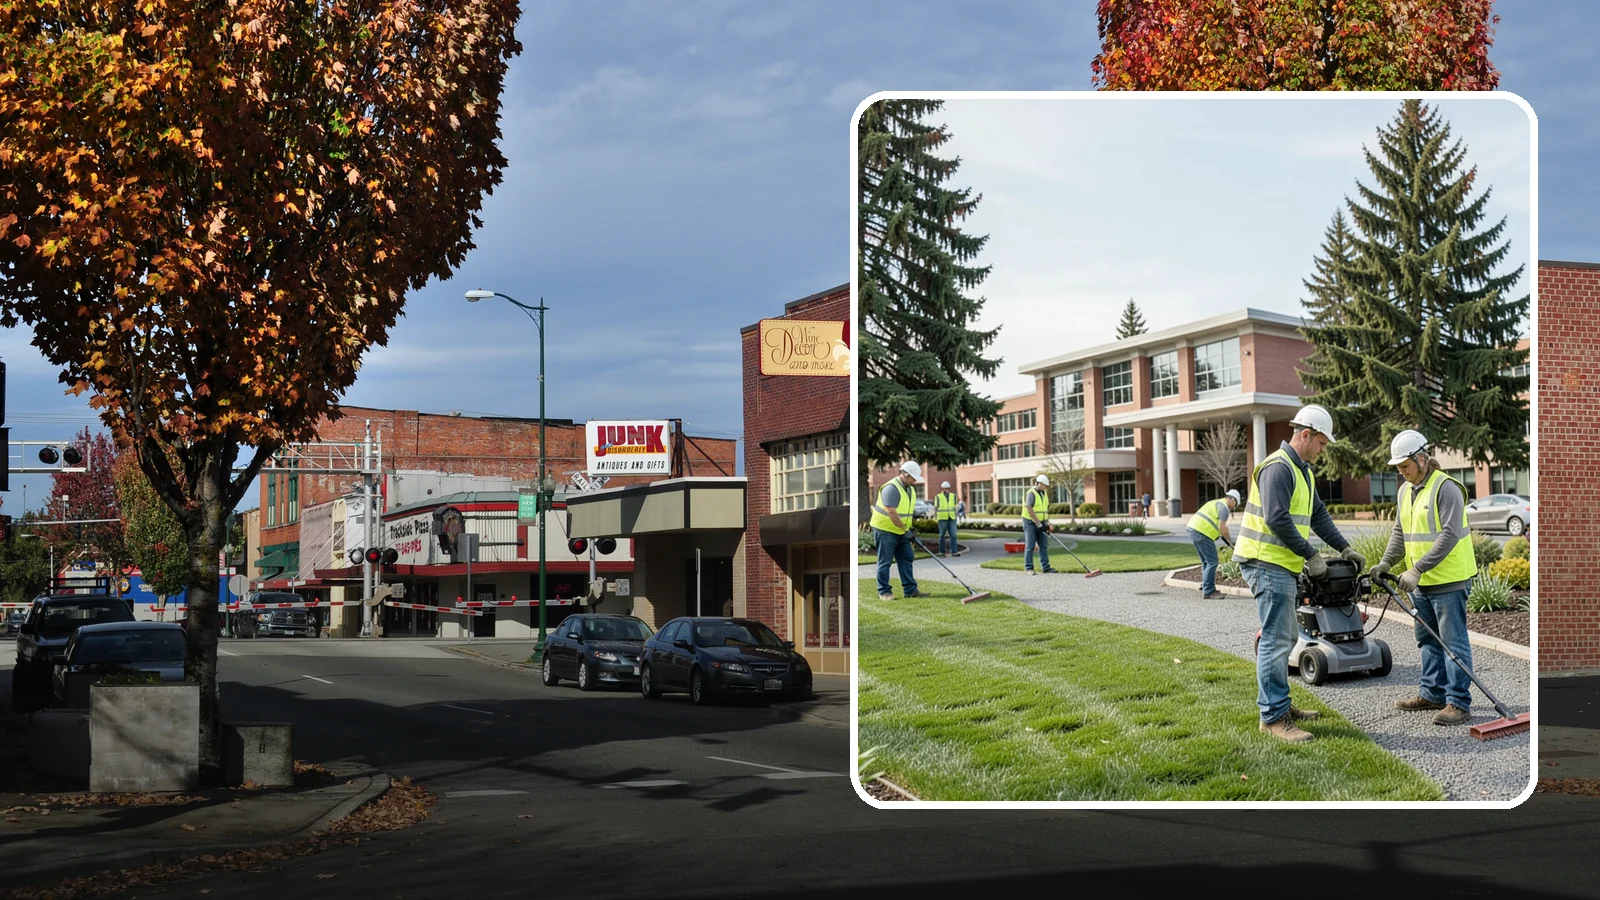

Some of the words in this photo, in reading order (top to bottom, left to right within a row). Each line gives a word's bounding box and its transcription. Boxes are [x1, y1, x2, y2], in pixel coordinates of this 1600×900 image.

[595, 425, 665, 457] JUNK
[607, 446, 645, 454] DISORDERLY
[597, 461, 628, 470] ANTIQUES
[631, 461, 644, 469] AND
[647, 461, 665, 469] GIFTS
[390, 522, 413, 539] Trackside
[414, 519, 429, 535] Pizza
